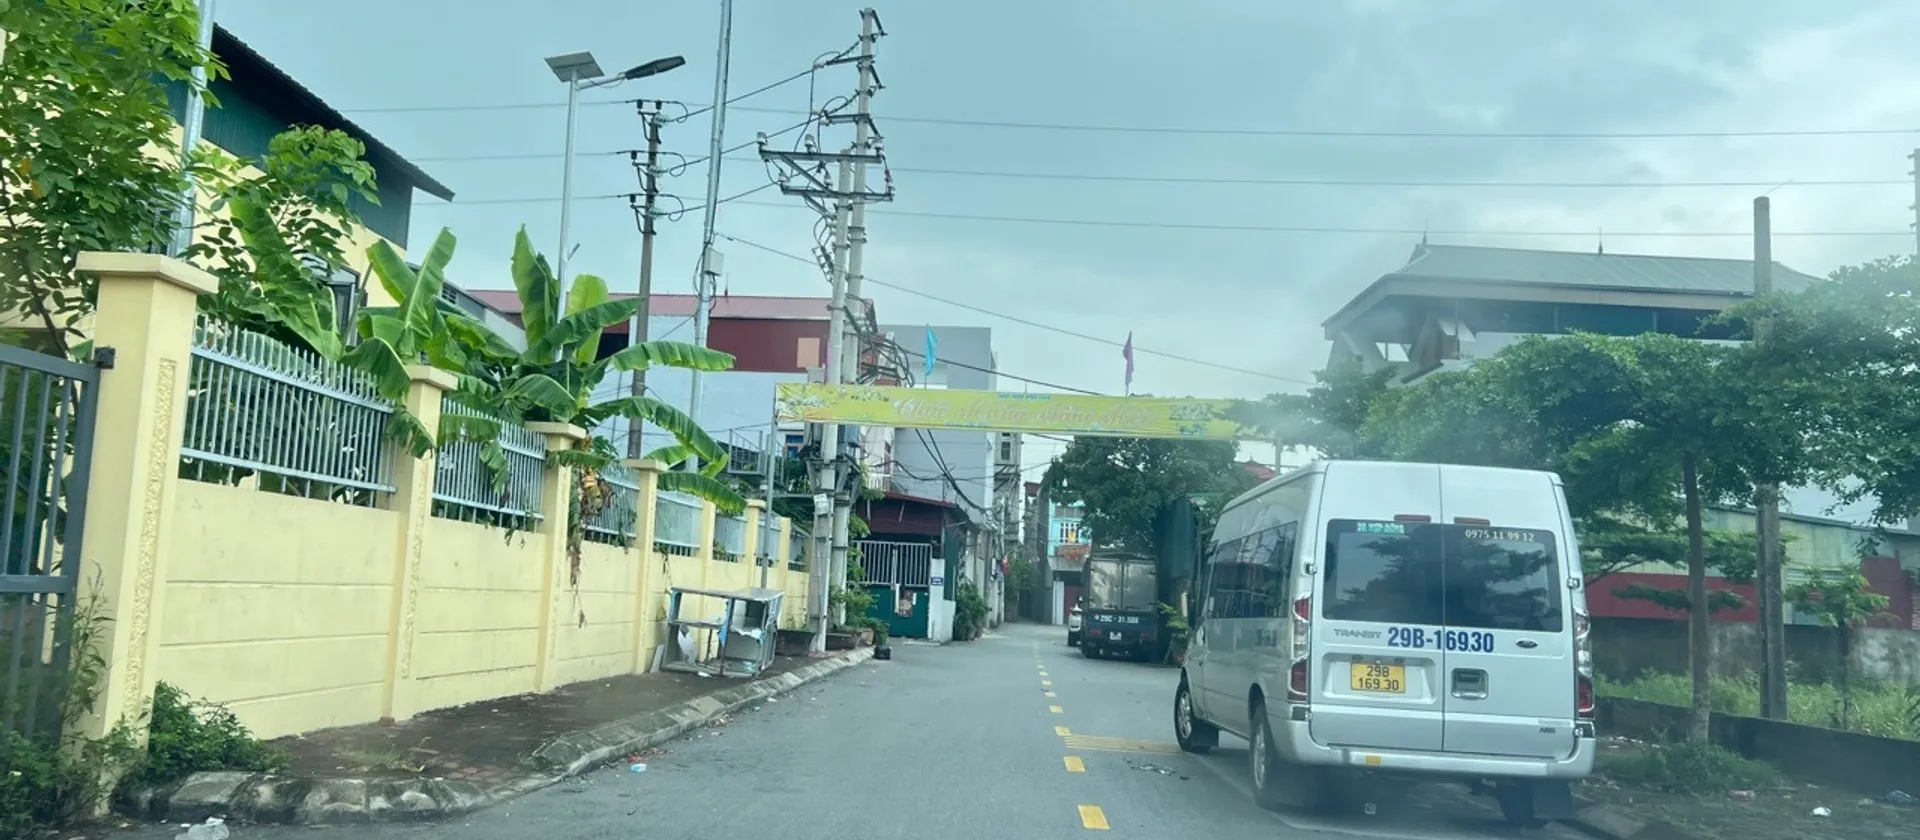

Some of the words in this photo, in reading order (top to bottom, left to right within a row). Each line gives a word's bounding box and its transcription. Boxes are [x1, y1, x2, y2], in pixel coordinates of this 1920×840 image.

[1465, 528, 1490, 540] 0975
[1492, 530, 1504, 541] 11
[1507, 531, 1520, 541] 99
[1522, 532, 1535, 543] 12
[1333, 628, 1383, 639] TRANSIT
[1366, 665, 1390, 677] 29B
[1357, 677, 1400, 691] 169.30
